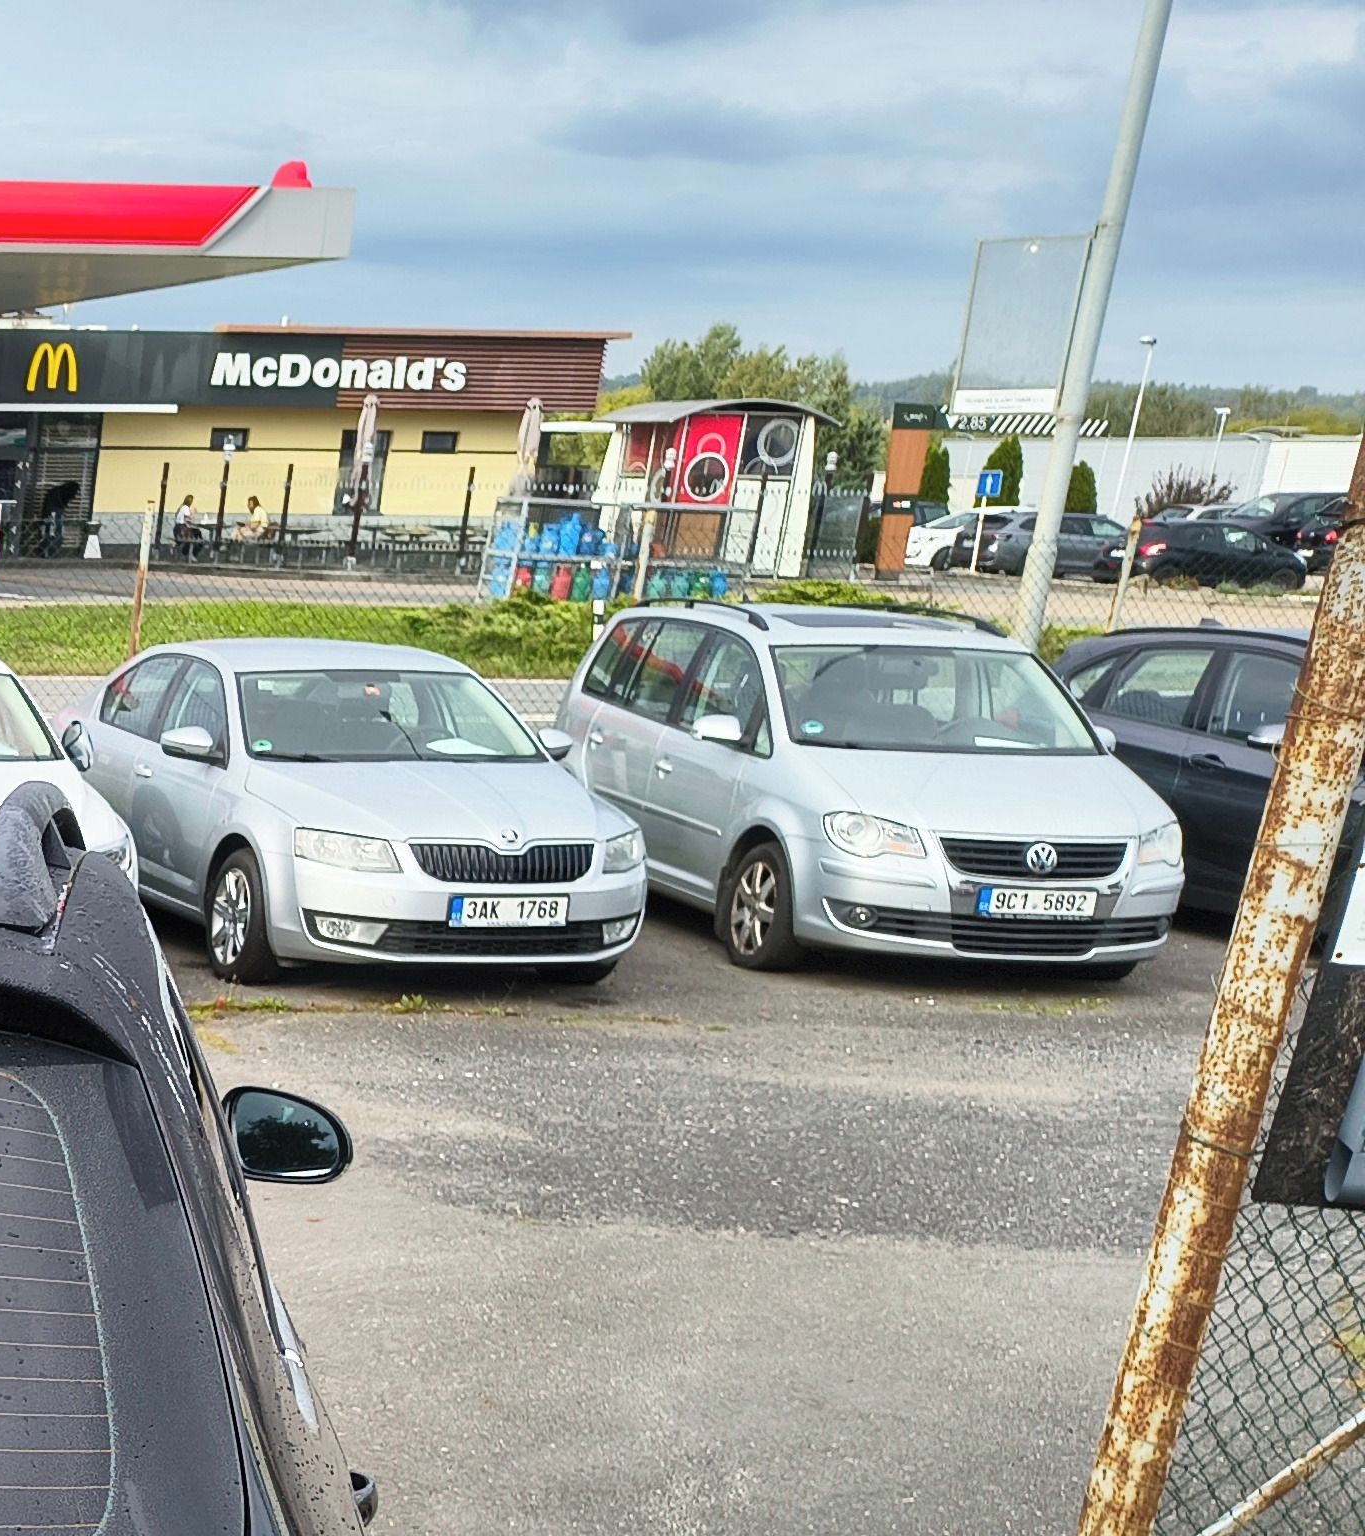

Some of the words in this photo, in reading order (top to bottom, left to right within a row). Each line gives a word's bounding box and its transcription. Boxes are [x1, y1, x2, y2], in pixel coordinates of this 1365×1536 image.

[210, 352, 467, 391] McDonald's
[467, 901, 501, 919] 3AK
[517, 900, 559, 919] 1768
[995, 893, 1028, 910] 9C1
[1043, 894, 1087, 911] 5892
